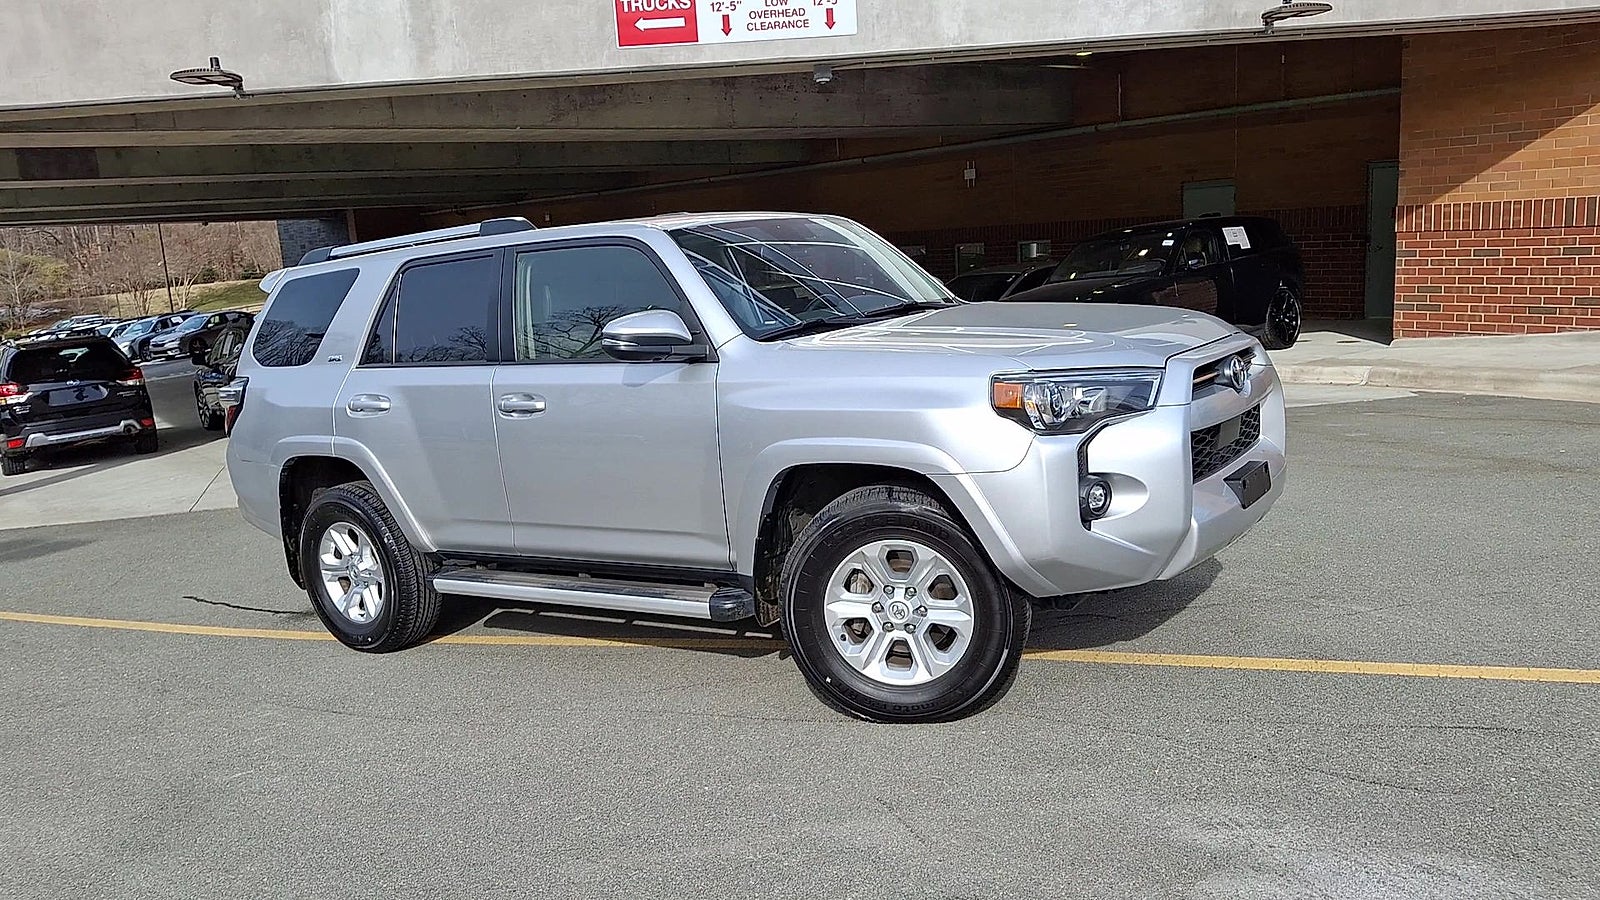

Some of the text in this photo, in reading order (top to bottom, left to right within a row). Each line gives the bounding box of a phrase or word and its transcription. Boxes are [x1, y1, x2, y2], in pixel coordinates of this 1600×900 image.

[621, 0, 692, 12] TRUCKS
[748, 8, 806, 19] OVERHEAD
[746, 19, 810, 31] CLEARANCE
